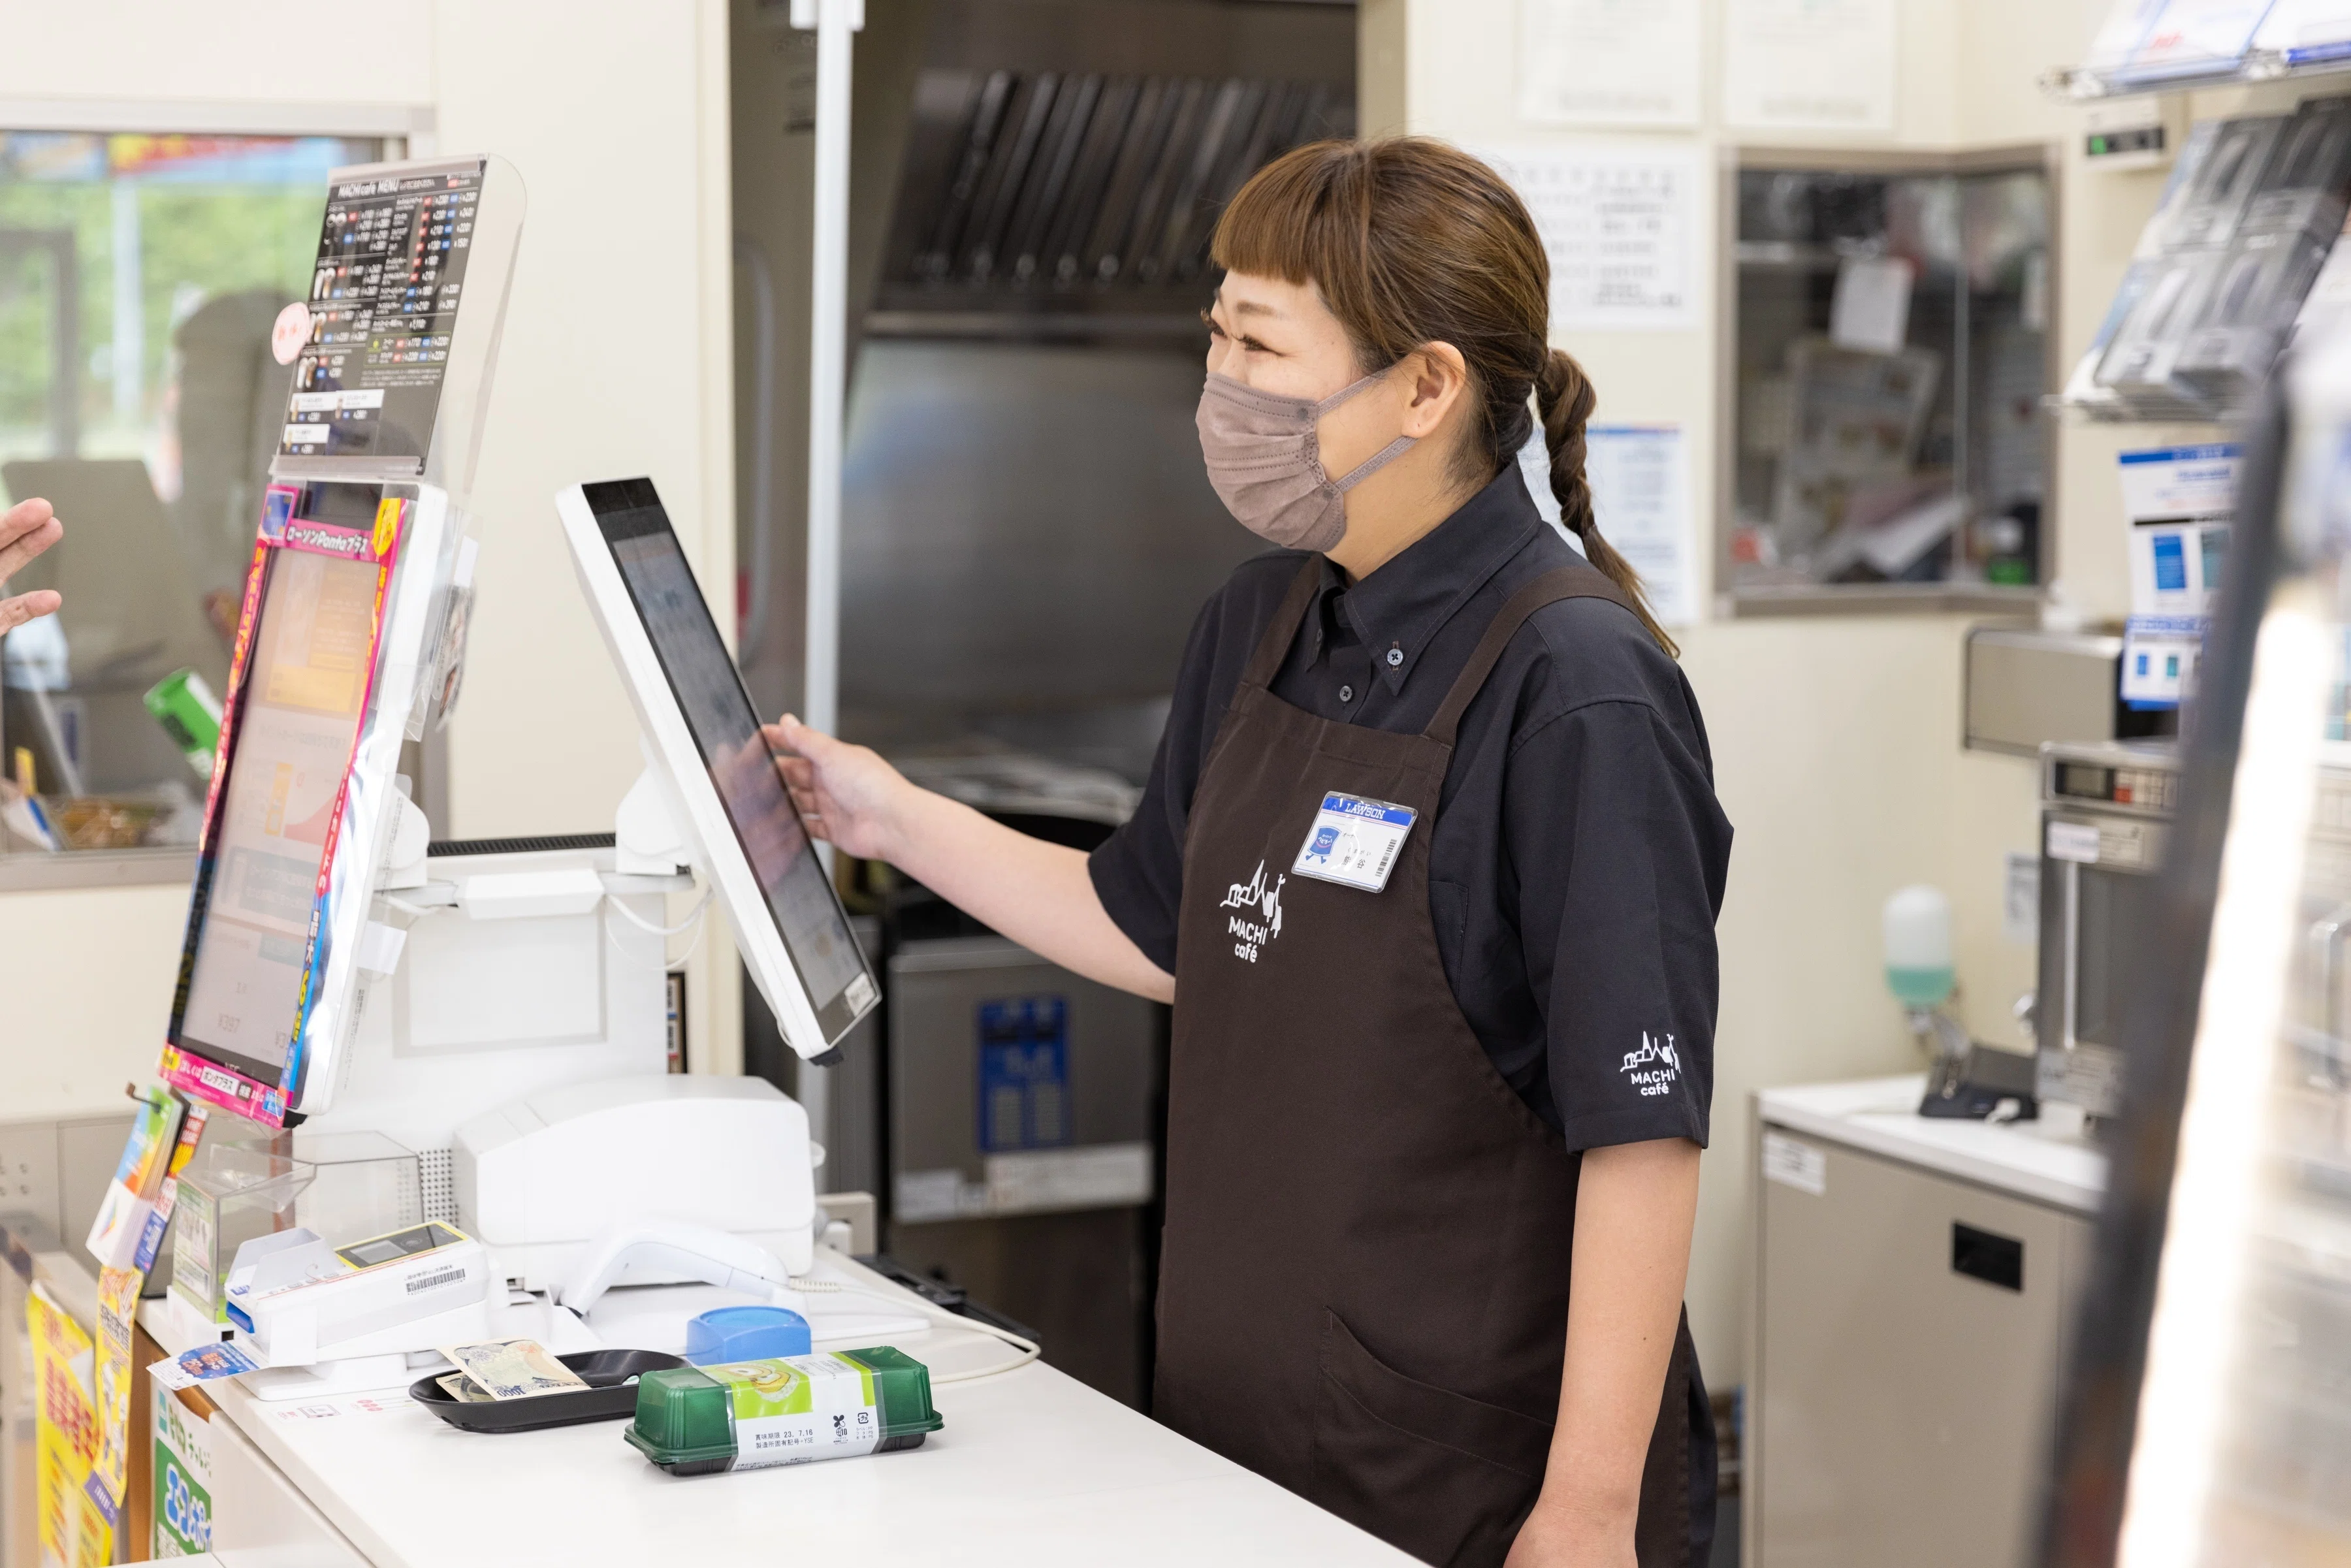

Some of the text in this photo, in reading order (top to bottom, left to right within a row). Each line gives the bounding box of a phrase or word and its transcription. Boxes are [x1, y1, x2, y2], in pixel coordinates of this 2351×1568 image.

[338, 183, 360, 198] MACHI
[377, 178, 400, 193] MENU
[286, 526, 369, 554] ローソンPontaプラス
[1345, 803, 1385, 820] LAWSON
[1228, 916, 1268, 945] MACHI
[1234, 942, 1258, 963] café
[1631, 1068, 1675, 1085] MACHI
[1640, 1082, 1669, 1096] café
[497, 1387, 526, 1398] 1000
[755, 1432, 780, 1441] 賞味期限
[841, 1428, 848, 1436] 10
